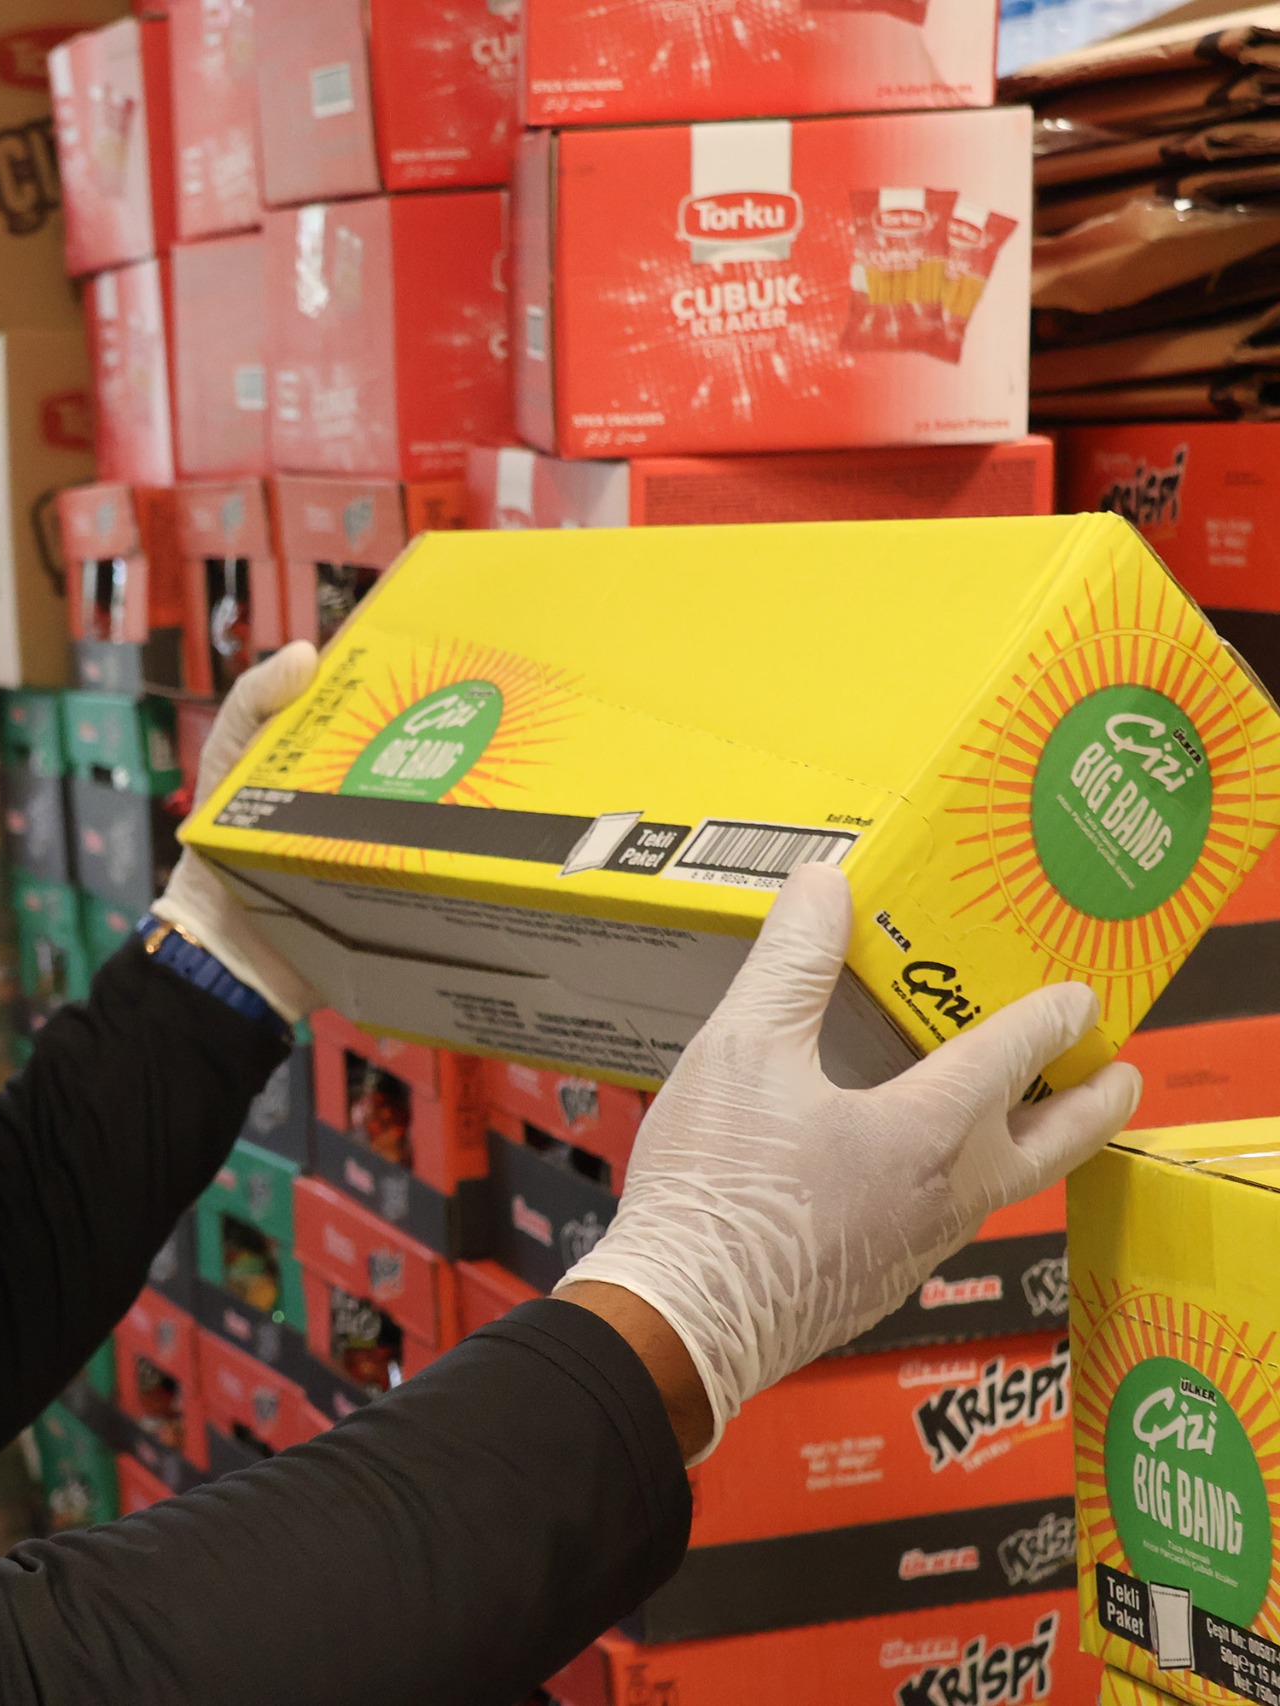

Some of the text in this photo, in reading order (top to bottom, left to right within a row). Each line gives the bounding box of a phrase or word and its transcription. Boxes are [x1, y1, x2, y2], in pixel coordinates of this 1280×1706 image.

[692, 198, 785, 232] Torku
[690, 309, 788, 338] KRAKER
[1071, 742, 1173, 871] BIG BANG
[636, 828, 677, 849] Tekli
[618, 847, 665, 869] Paket
[875, 910, 912, 952] ÜLKER
[891, 980, 907, 1000] Taco
[1180, 1377, 1216, 1404] ÜLKER
[1133, 1453, 1243, 1555] BIG BANG
[1106, 1576, 1140, 1611] Tekli
[1106, 1601, 1145, 1638] Paket
[1206, 1617, 1230, 1643] Çeşit
[1257, 1663, 1270, 1683] 15
